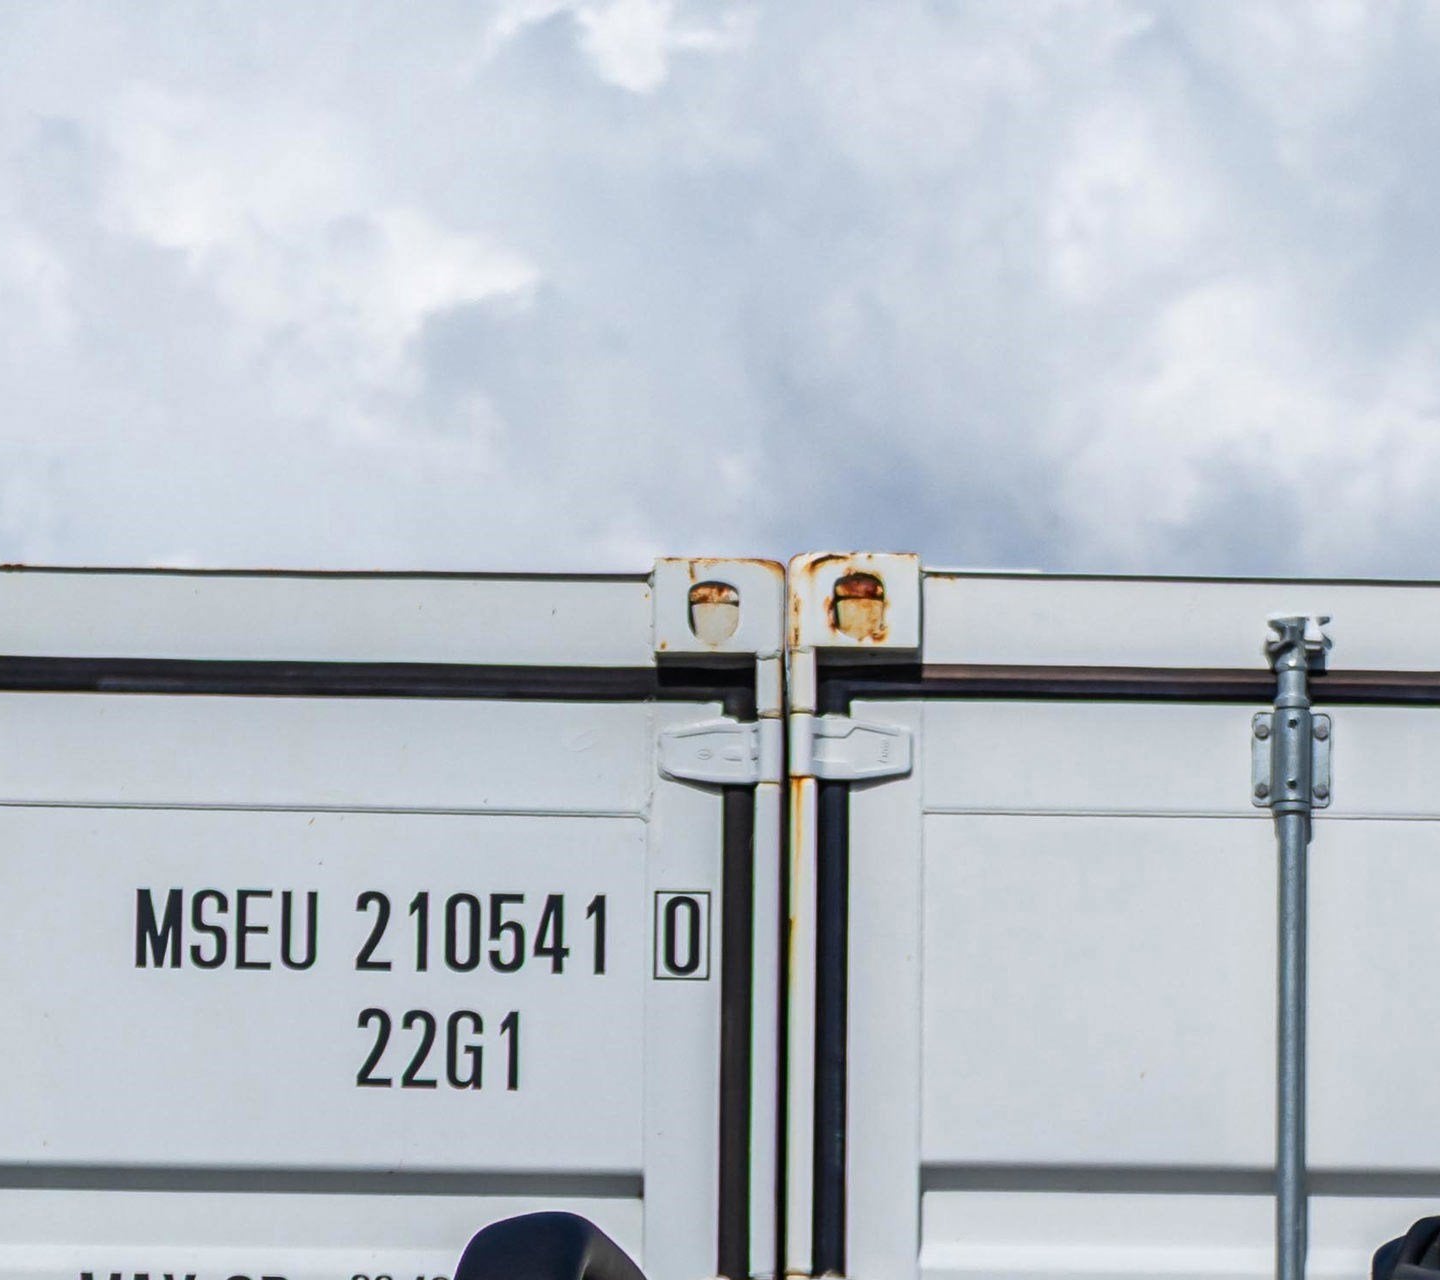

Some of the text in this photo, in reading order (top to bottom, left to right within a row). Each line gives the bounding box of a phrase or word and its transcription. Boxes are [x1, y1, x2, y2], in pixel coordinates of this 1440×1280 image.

[135, 888, 701, 976] MSEU 210541 0
[356, 1007, 520, 1091] 22G1
